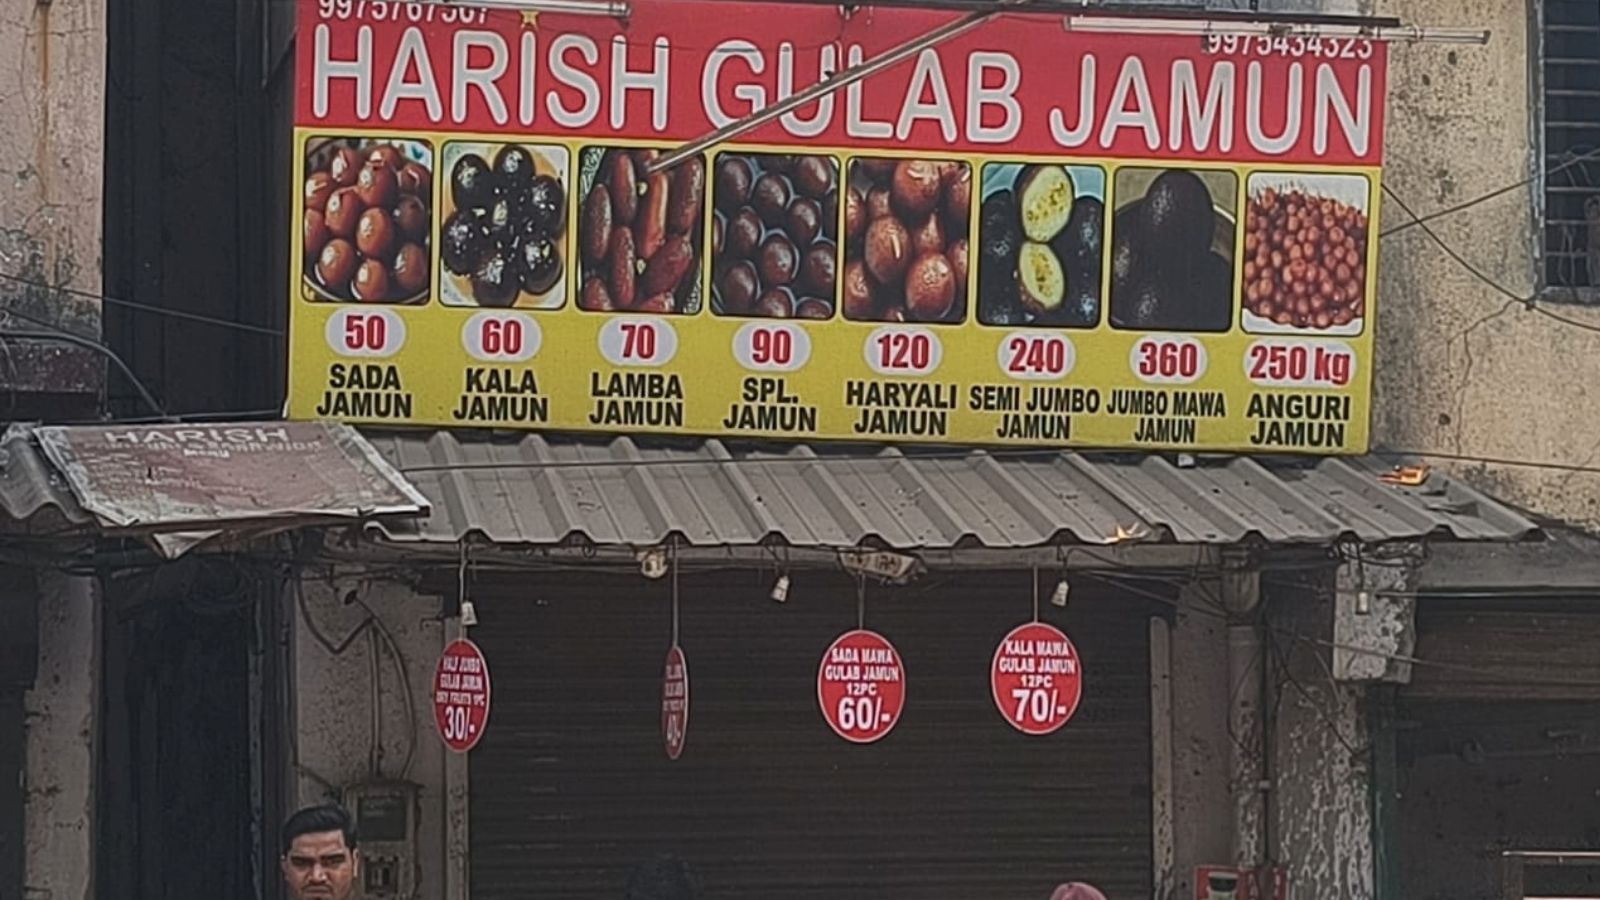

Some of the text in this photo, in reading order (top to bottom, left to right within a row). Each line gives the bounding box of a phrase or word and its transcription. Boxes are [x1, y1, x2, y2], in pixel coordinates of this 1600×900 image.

[313, 24, 1372, 156] HARISH GULAB JAMUN
[345, 315, 386, 350] 50
[482, 320, 522, 355] 60
[620, 324, 656, 359] 70
[751, 329, 791, 364] 90
[877, 334, 929, 369] 120
[1009, 338, 1064, 373] 240
[1139, 342, 1198, 378] 360
[329, 364, 401, 390] SADA
[1250, 346, 1350, 385] 250 kg
[466, 368, 537, 394] KALA
[591, 372, 683, 399] LAMBA
[742, 378, 799, 403] SPL.
[317, 391, 412, 418] JAMUN
[453, 396, 548, 422] JAMUN
[846, 382, 957, 409] HARYALI
[969, 385, 1100, 413] SEMI JUMBO
[1107, 388, 1226, 417] JUMBO MAWA
[1246, 393, 1350, 420] ANGURI
[590, 400, 683, 427] JAMUN
[723, 404, 817, 431] JAMUN
[854, 409, 947, 435] JAMUN
[997, 414, 1071, 439] JAMUN
[105, 428, 288, 443] HARISH
[1134, 418, 1196, 443] JAMUN
[1250, 420, 1344, 447] JAMUN
[832, 648, 892, 664] SADA MAWA
[1006, 640, 1069, 656] KALA MAWA
[826, 665, 899, 682] GULAB JAMUN
[1000, 657, 1075, 674] GULAB JAMUN
[846, 683, 877, 696] 12PC
[1021, 675, 1053, 688] 12PC
[838, 697, 890, 730] 60/-
[1013, 689, 1067, 722] 70/-
[445, 706, 475, 741] 30/-
